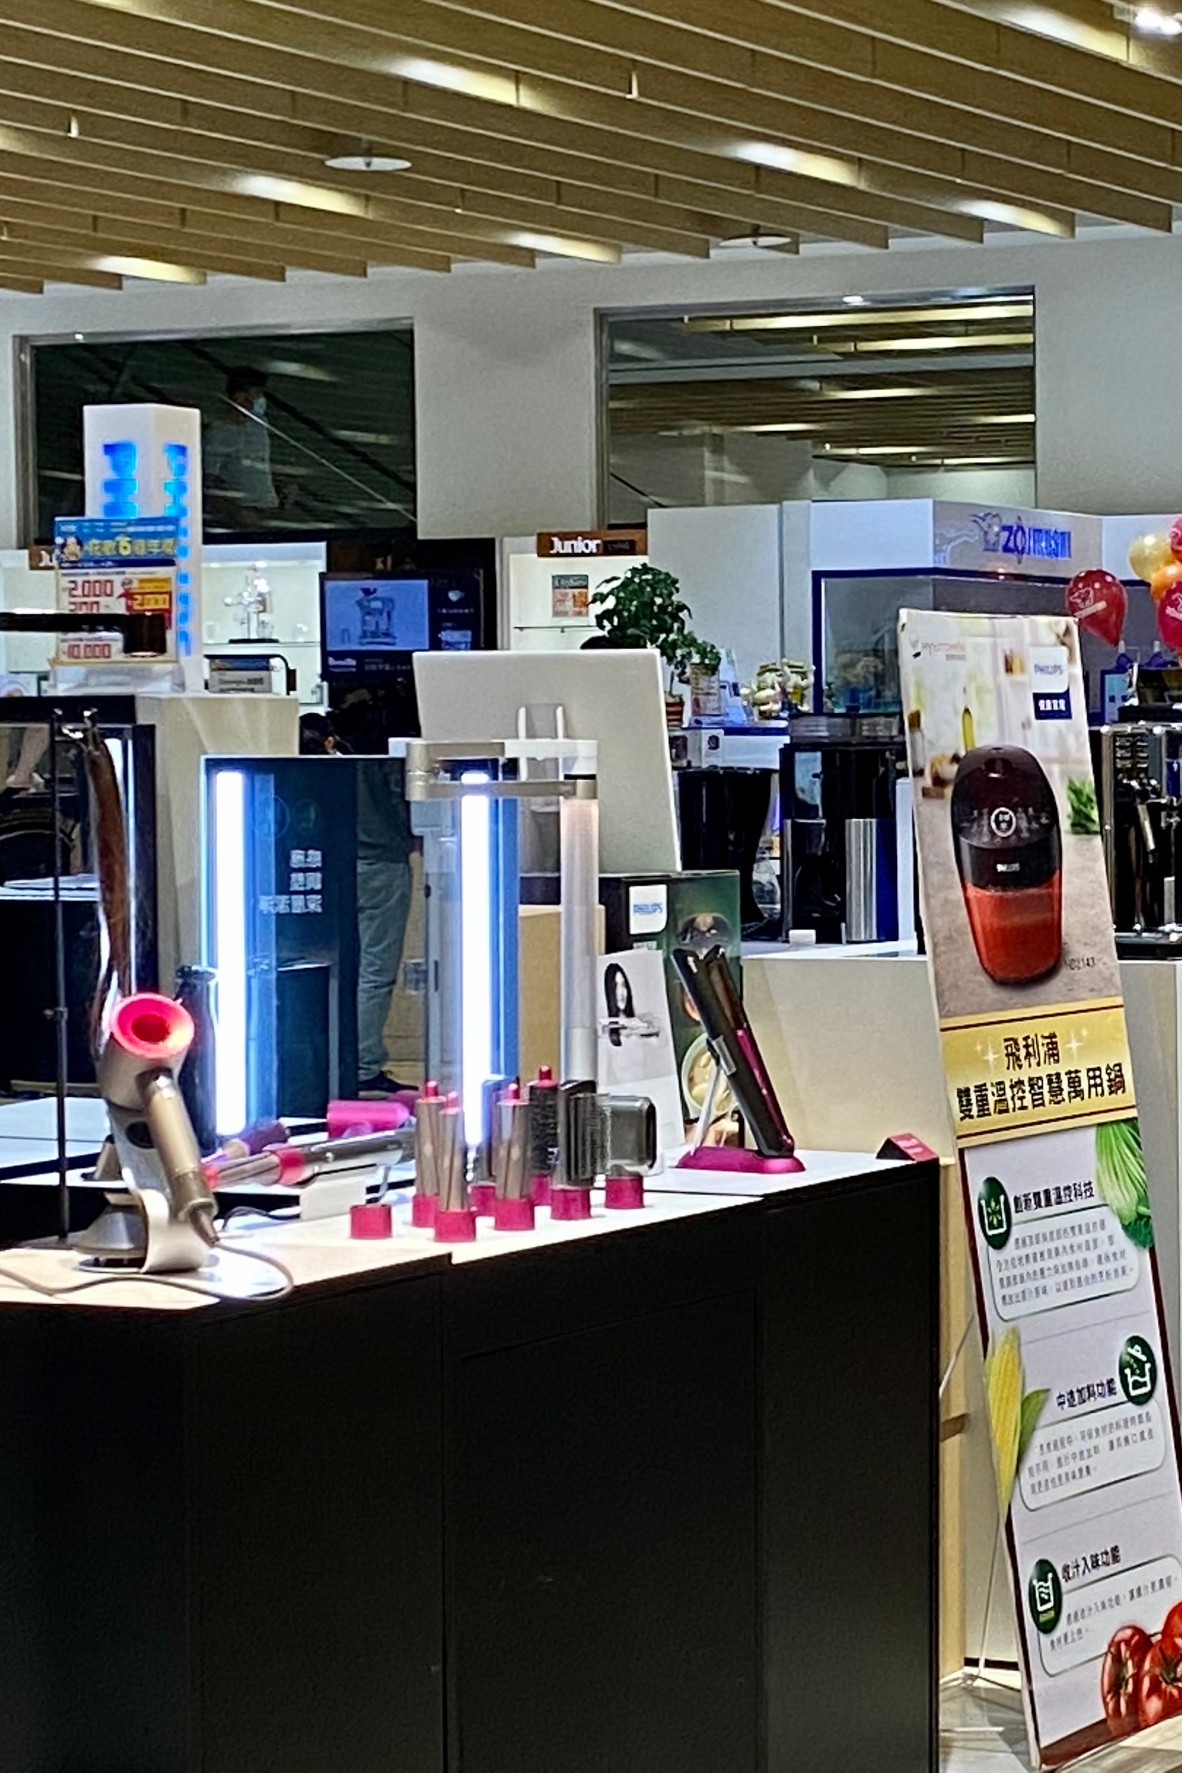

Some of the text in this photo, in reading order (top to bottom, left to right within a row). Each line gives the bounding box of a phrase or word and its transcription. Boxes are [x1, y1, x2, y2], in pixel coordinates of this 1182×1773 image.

[549, 536, 602, 554] Junior
[1003, 1032, 1060, 1071] 飛利浦
[957, 1063, 1126, 1121] 雙重溫控智慧萬用鍋
[1060, 1545, 1121, 1582] 收汁入味功能
